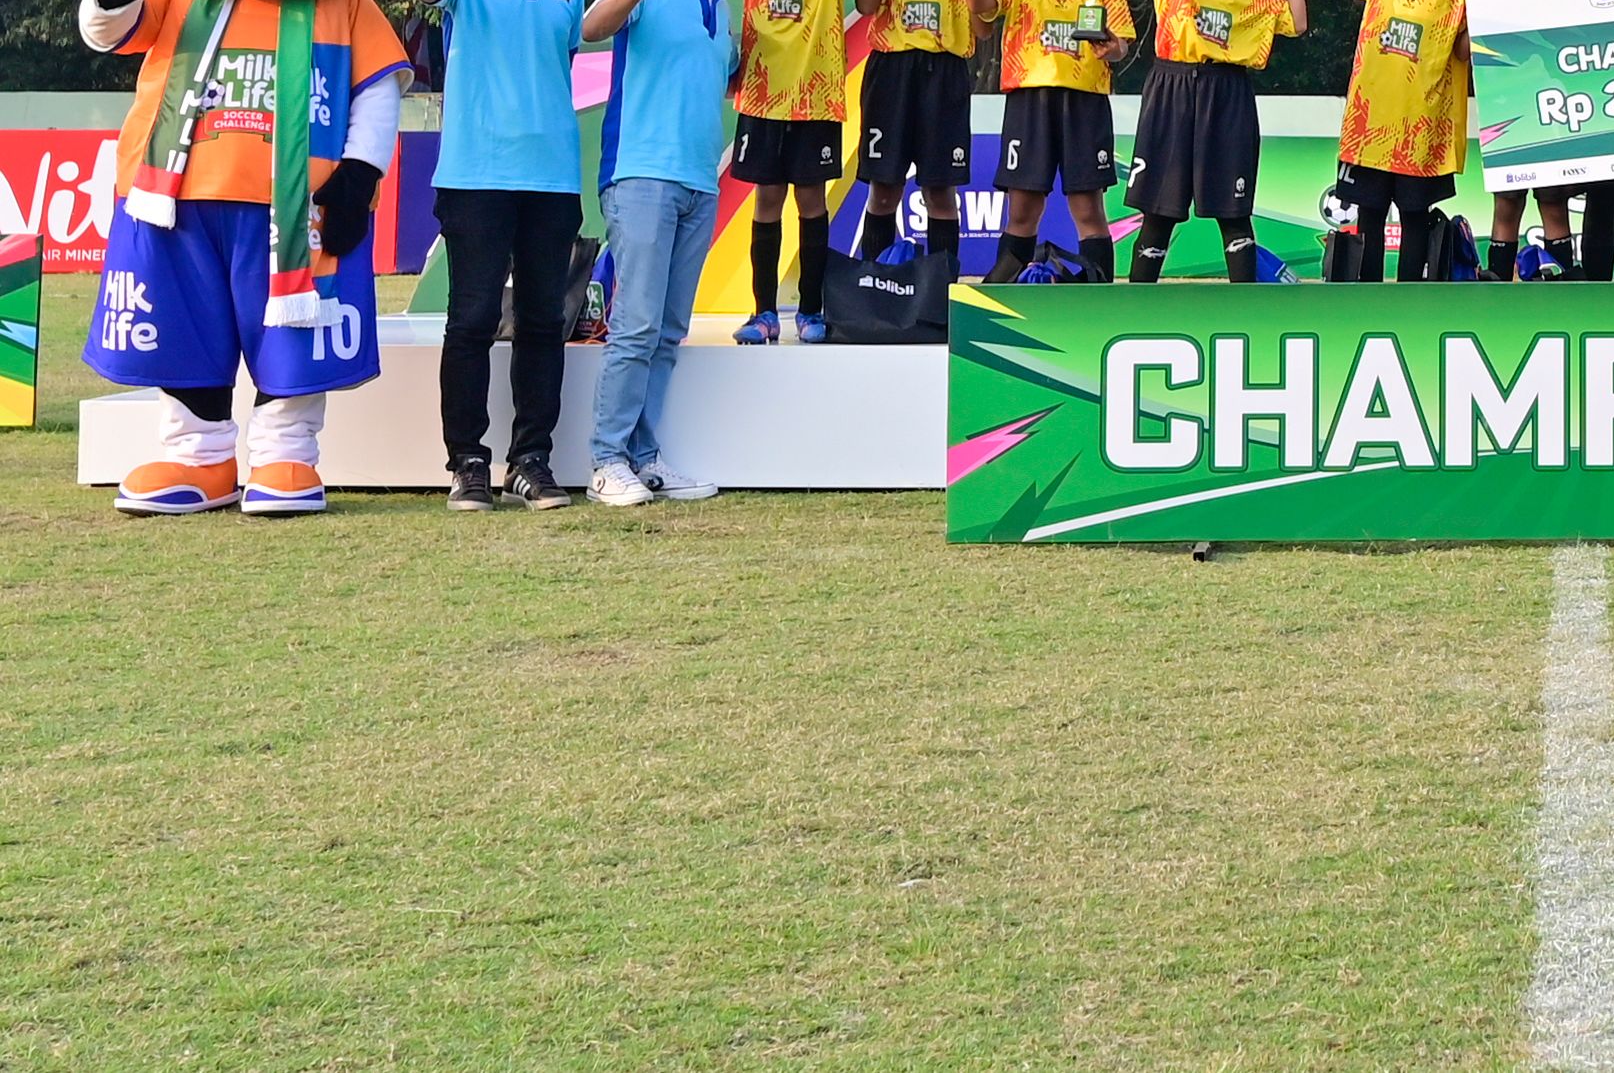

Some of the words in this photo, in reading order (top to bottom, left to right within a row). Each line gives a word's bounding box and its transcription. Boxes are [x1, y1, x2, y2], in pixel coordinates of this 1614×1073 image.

[908, 3, 937, 17] Milk
[1203, 21, 1228, 40] Life
[1390, 20, 1417, 41] Milk
[1052, 35, 1078, 51] Life
[1392, 35, 1417, 53] Life
[223, 111, 264, 120] SOCCER
[1536, 88, 1594, 132] Rp
[213, 119, 272, 132] CHALLENGE
[869, 128, 883, 158] 2
[1007, 139, 1021, 170] 6
[104, 270, 153, 314] Milk
[875, 277, 915, 295] blibli
[102, 311, 159, 352] Life
